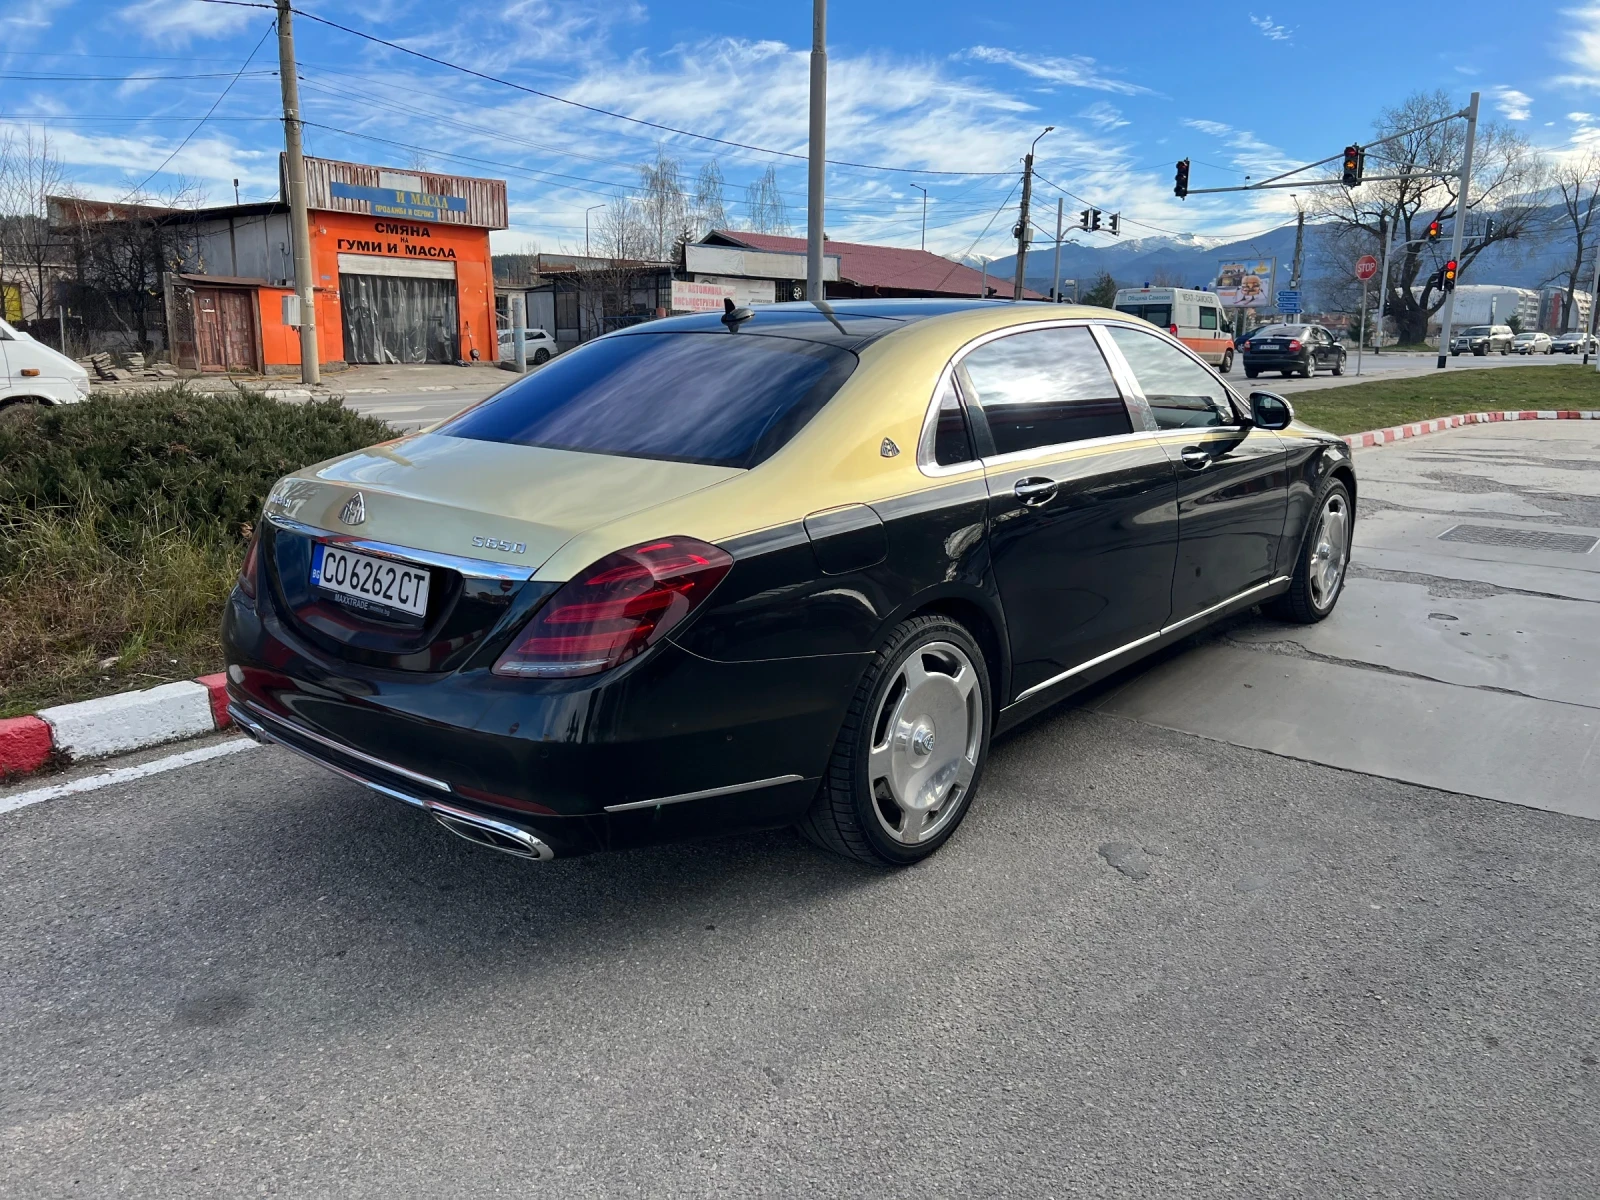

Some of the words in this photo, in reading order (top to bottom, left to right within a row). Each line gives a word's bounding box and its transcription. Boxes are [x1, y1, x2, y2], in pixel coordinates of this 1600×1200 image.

[396, 191, 406, 204] И
[410, 193, 448, 209] МАСЛА
[374, 222, 431, 238] СМЯНА
[337, 238, 382, 253] ГУМИ
[387, 242, 398, 254] И
[405, 244, 457, 259] МАСЛА
[1357, 262, 1375, 273] STOP
[312, 569, 321, 579] BG
